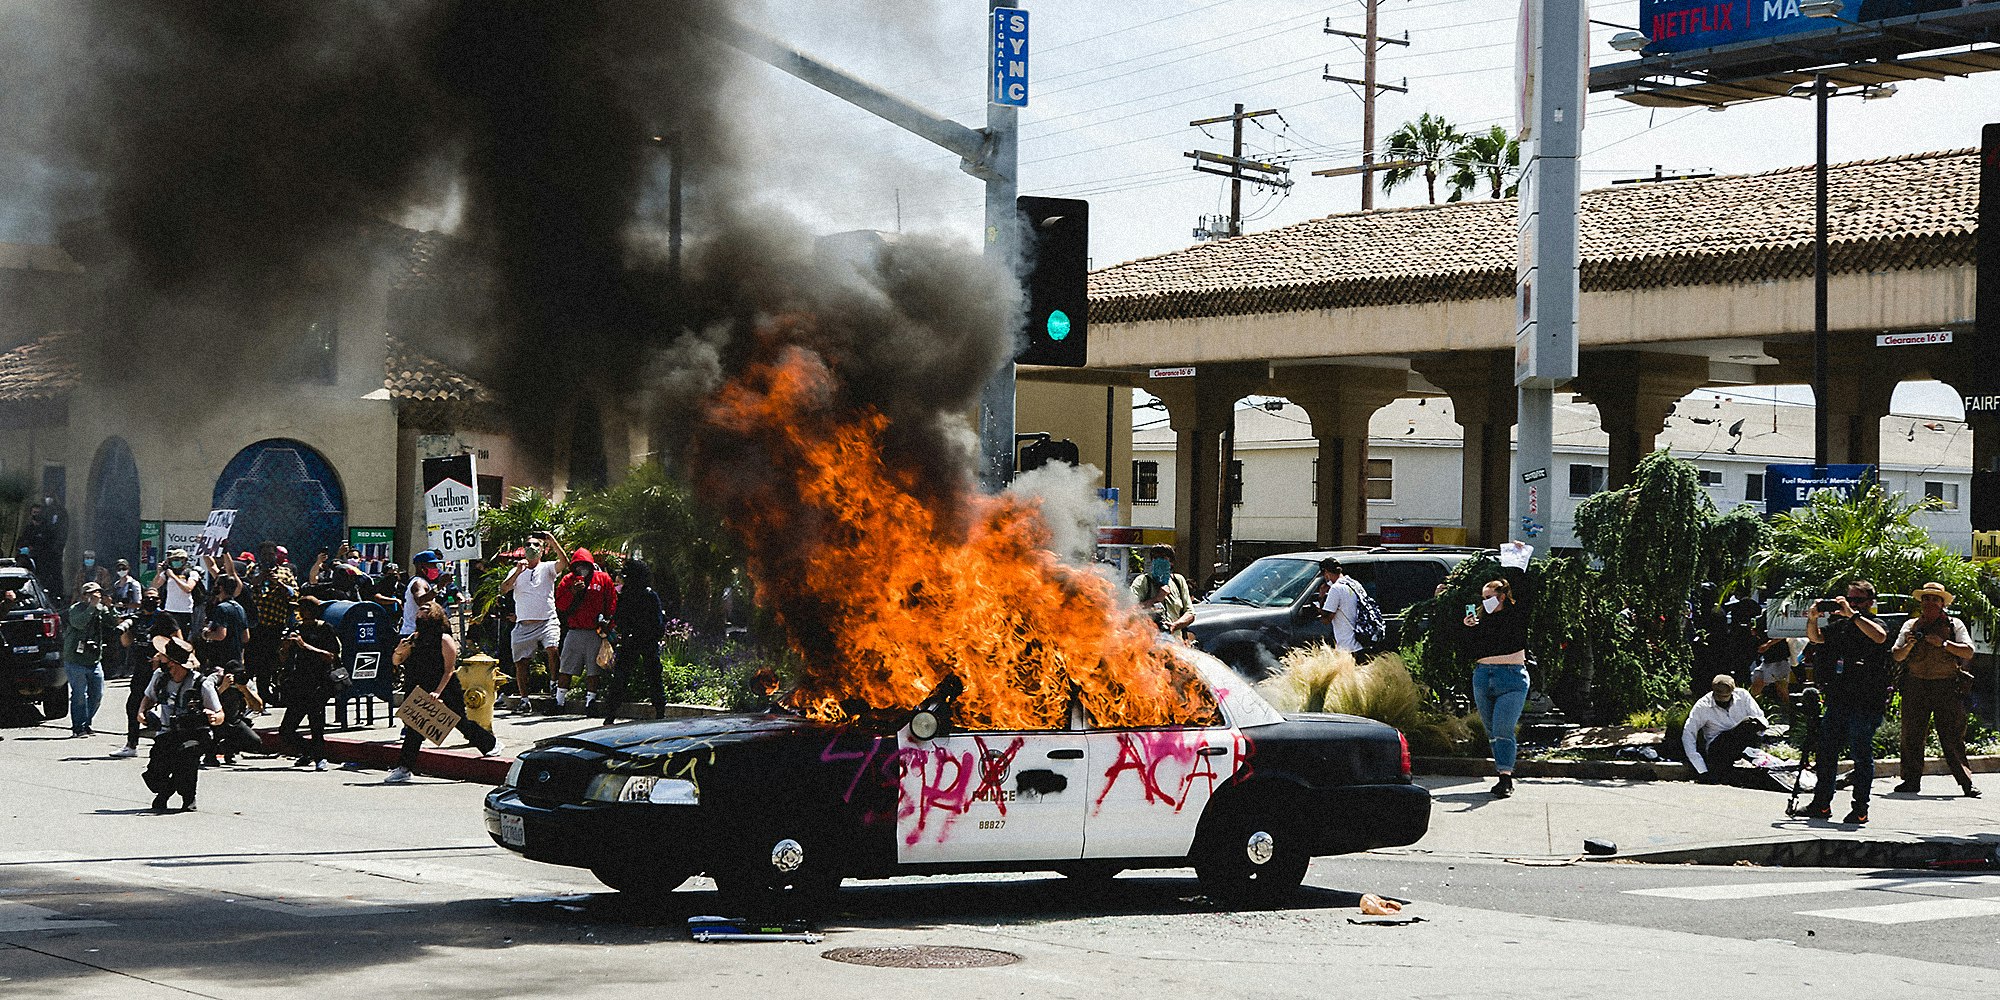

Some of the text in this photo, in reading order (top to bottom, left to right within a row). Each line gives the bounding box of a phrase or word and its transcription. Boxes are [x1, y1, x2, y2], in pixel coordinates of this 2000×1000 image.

[1652, 3, 1733, 42] NETFLIX
[1008, 15, 1025, 100] SYNC
[1884, 336, 1925, 345] Clearance
[431, 488, 469, 508] Marlboro
[168, 534, 187, 542] You
[443, 529, 476, 550] 6.65
[1423, 529, 1431, 542] 6
[360, 628, 366, 638] 3
[437, 713, 454, 727] NO
[426, 725, 442, 741] NO
[1093, 733, 1257, 814] ACAB
